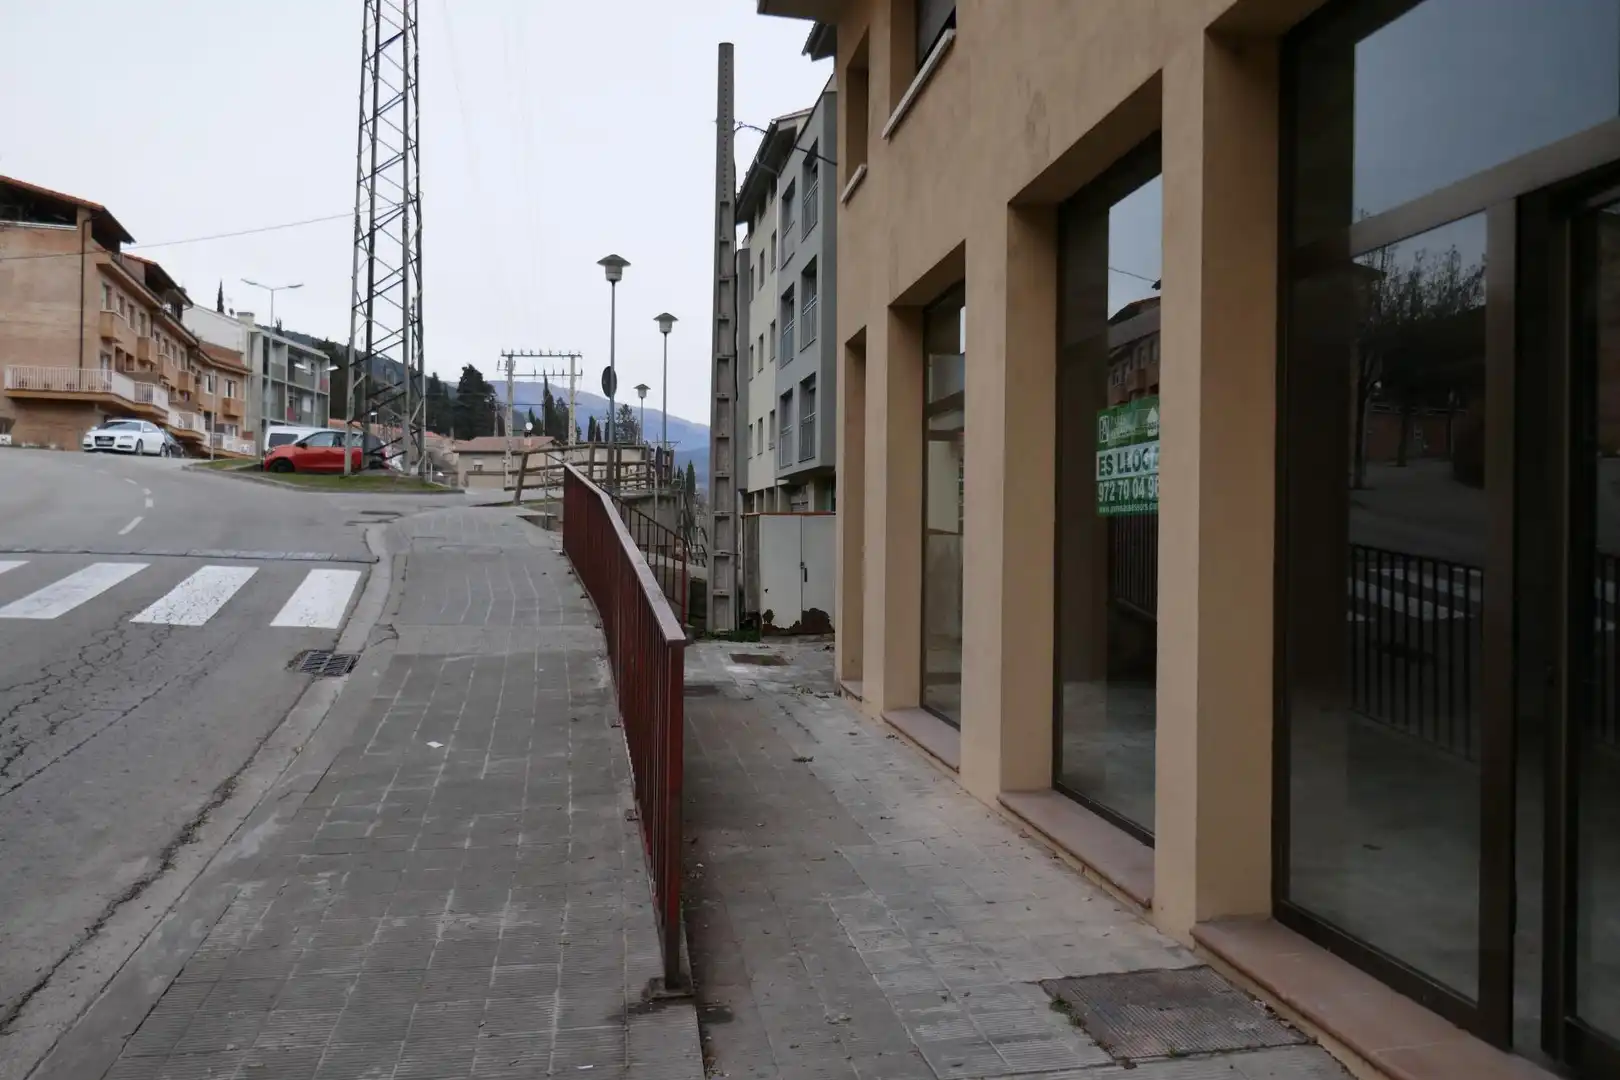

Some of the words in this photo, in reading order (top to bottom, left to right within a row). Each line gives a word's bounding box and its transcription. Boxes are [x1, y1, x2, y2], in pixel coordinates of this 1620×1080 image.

[1099, 454, 1113, 476] ES
[1098, 480, 1115, 502] 972
[1118, 479, 1130, 501] 70
[1132, 477, 1145, 499] 04
